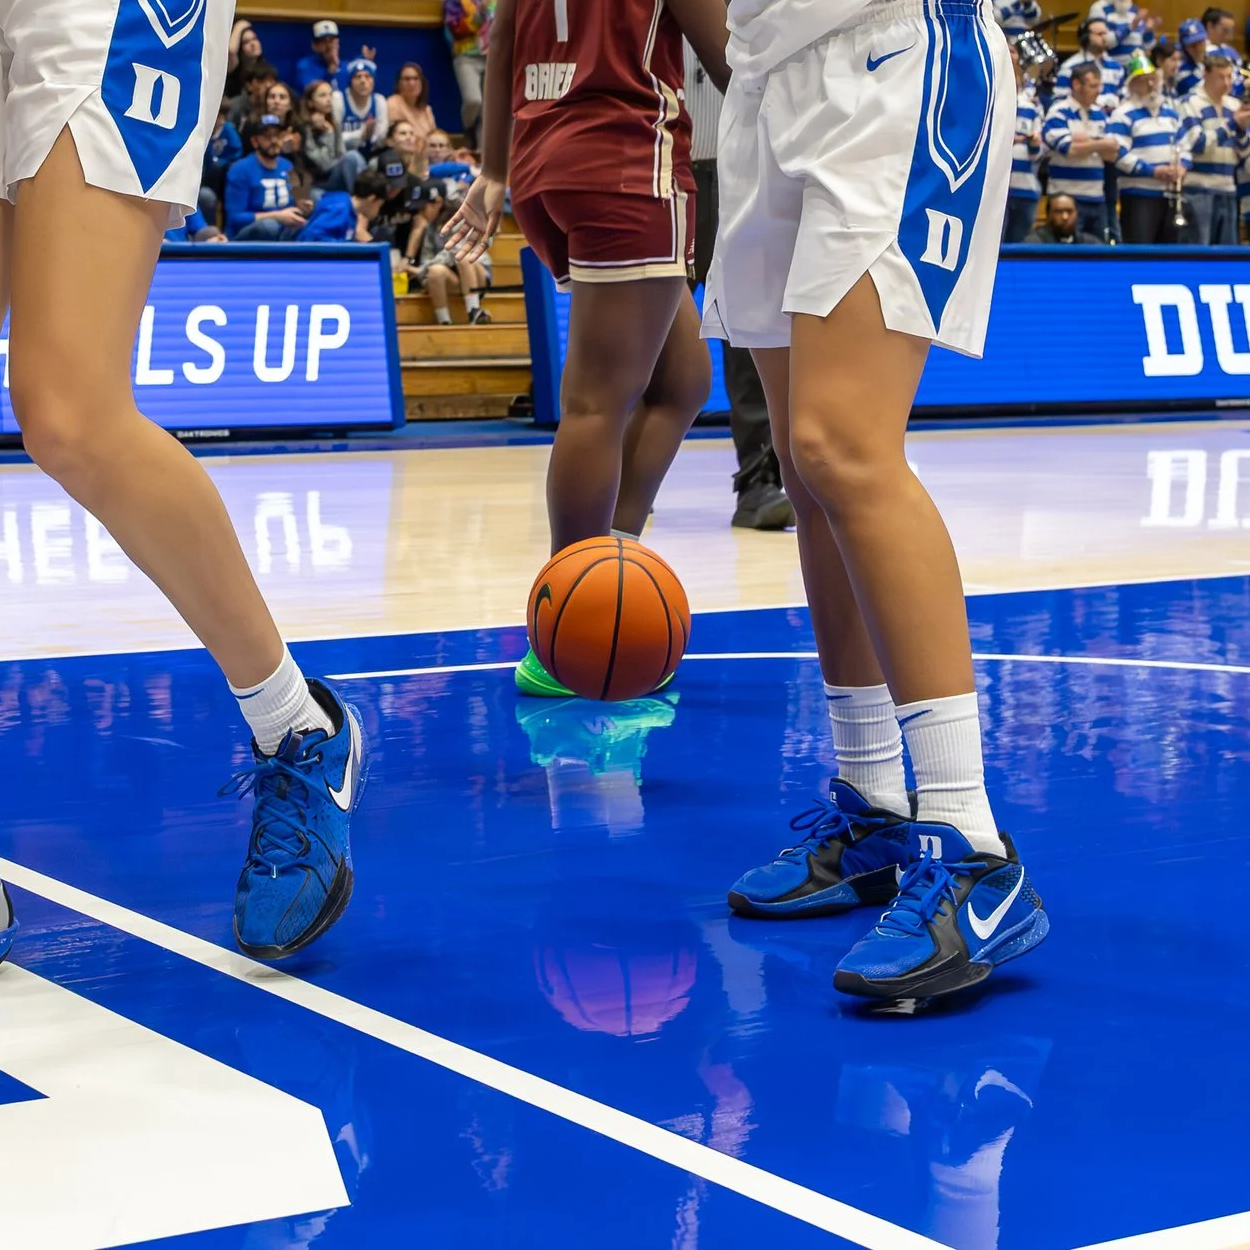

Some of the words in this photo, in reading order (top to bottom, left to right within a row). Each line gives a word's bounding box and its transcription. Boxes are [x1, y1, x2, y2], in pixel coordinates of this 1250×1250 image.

[124, 62, 181, 130] D
[920, 208, 964, 272] D
[253, 303, 351, 383] UP
